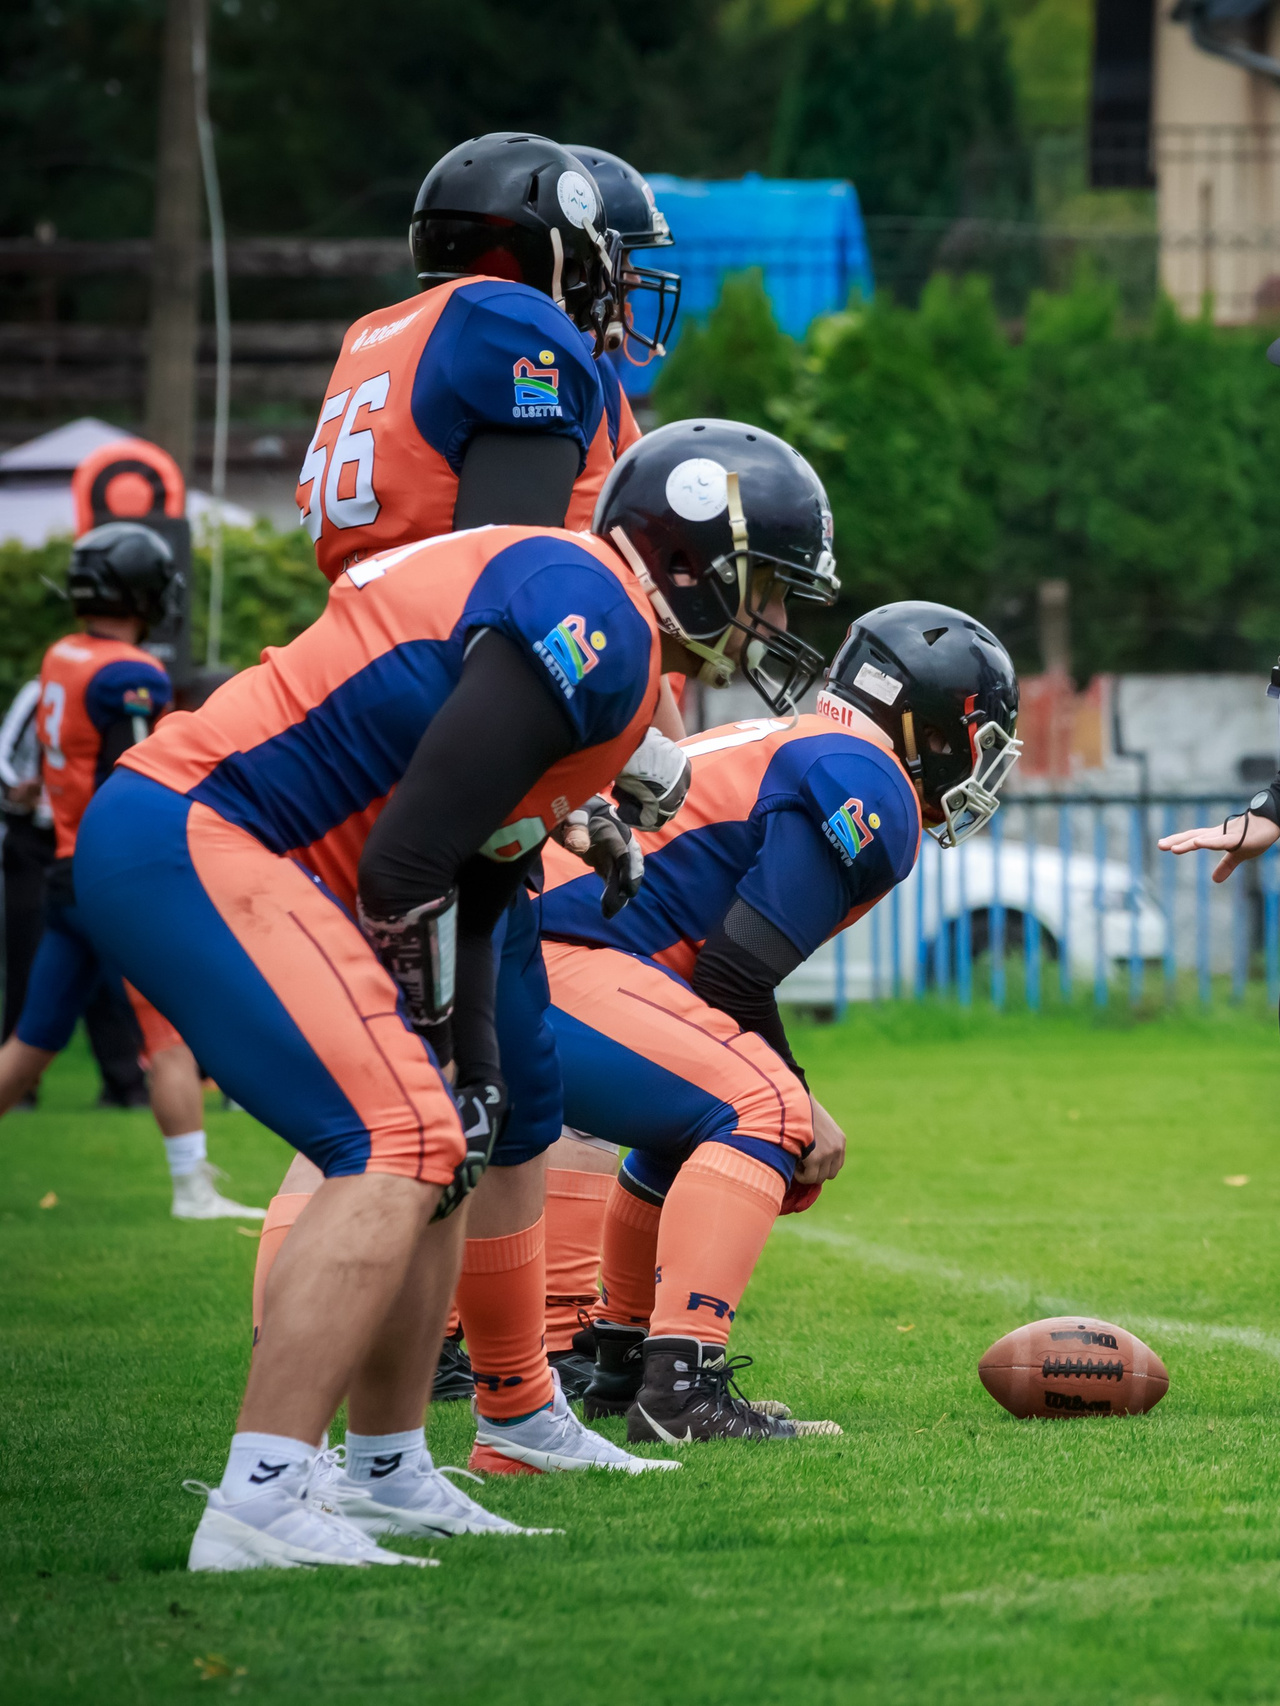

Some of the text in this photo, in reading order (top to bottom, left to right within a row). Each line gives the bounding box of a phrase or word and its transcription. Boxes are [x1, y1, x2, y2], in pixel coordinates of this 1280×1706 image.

[512, 405, 563, 418] OLSZTYN
[299, 371, 393, 543] 56
[532, 640, 576, 699] OLSZTYN
[816, 697, 853, 728] ddell
[821, 821, 854, 868] OLSZTYN
